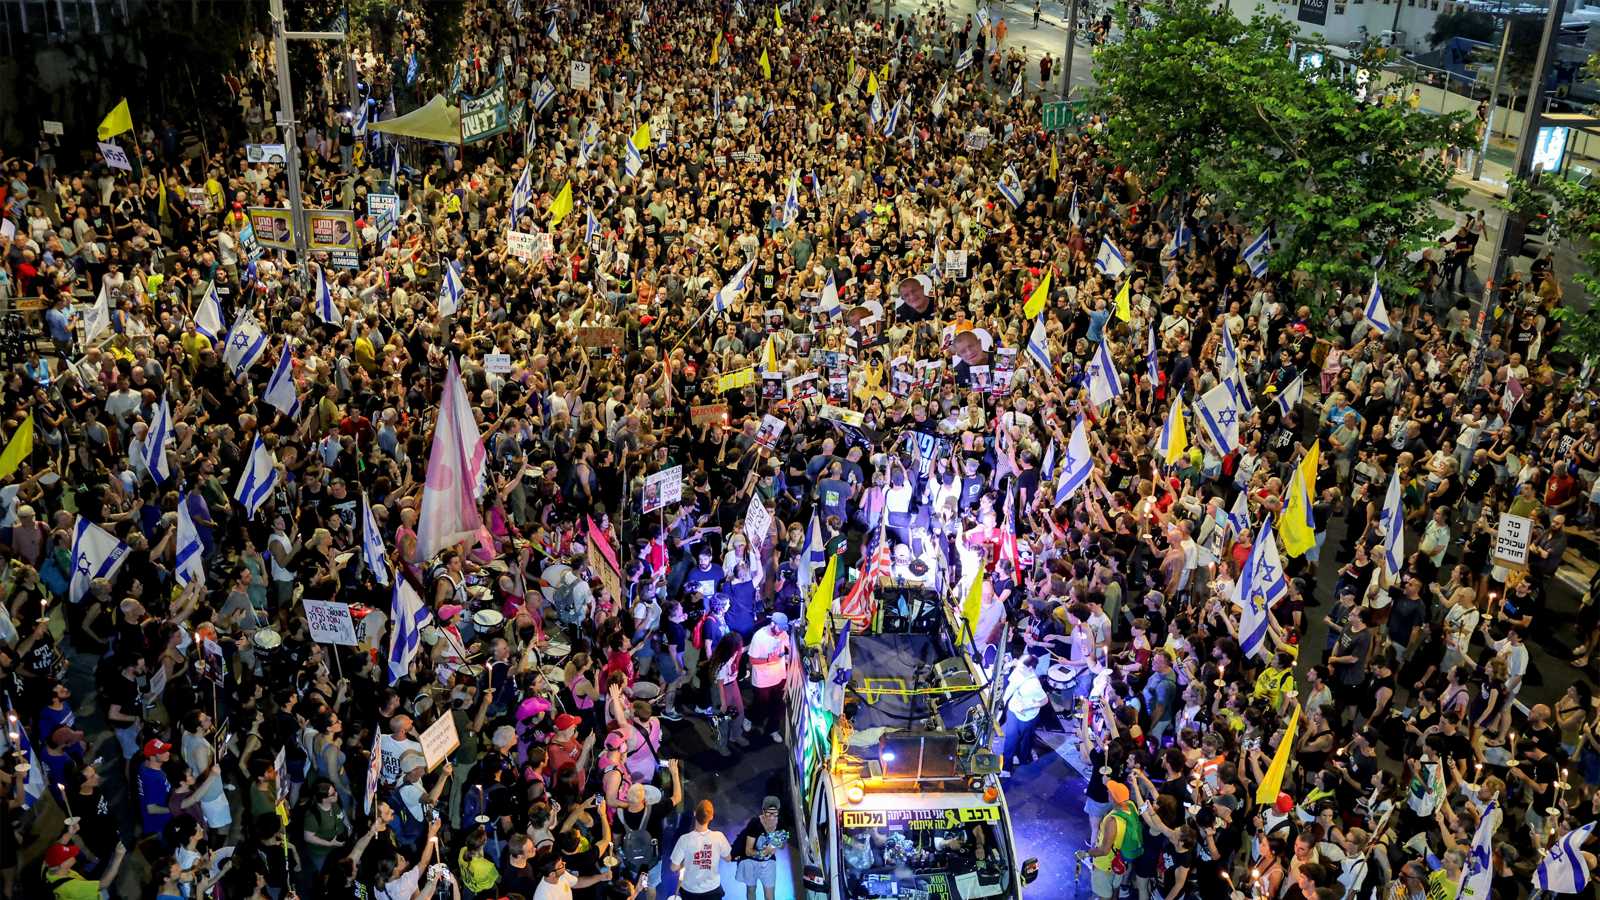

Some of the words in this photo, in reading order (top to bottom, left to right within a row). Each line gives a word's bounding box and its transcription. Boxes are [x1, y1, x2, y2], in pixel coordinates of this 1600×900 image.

[574, 63, 586, 72] לא
[1498, 537, 1525, 549] שכולם
[1498, 546, 1523, 558] חוזרים
[847, 812, 883, 825] מלווה
[888, 810, 912, 821] הביתה
[913, 809, 932, 820] בדרך
[932, 809, 945, 819] אני
[969, 809, 992, 820] רכב
[908, 819, 932, 830] איתם?
[934, 819, 946, 829] מה
